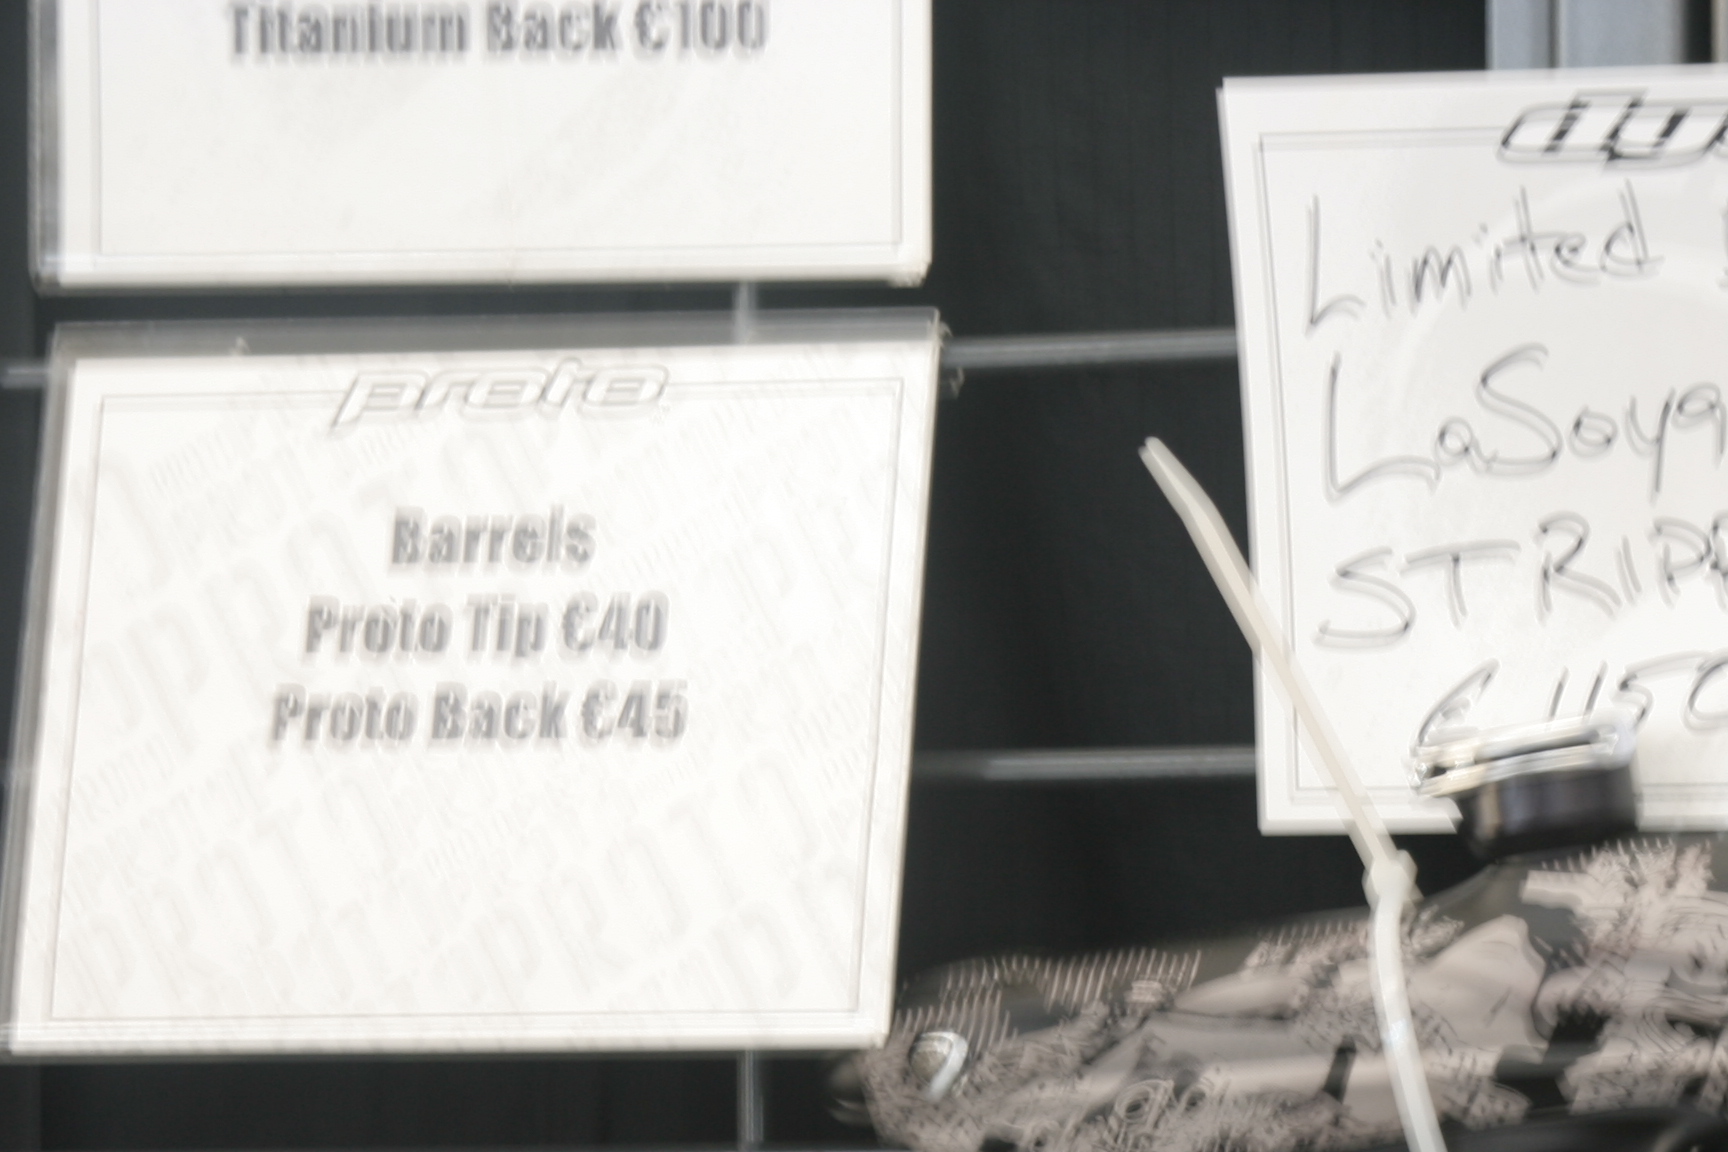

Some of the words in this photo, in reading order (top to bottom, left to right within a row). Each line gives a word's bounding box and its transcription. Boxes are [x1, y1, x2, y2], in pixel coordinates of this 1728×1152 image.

[230, 0, 468, 56] Titanium
[486, 0, 618, 56] Back
[1306, 180, 1658, 330] Limited
[390, 504, 598, 570] Barrels
[304, 594, 452, 660] Proto
[466, 594, 546, 660] Tip
[560, 590, 670, 652] €40
[270, 682, 416, 748] Proto
[430, 680, 570, 746] Back
[580, 678, 690, 742] €45
